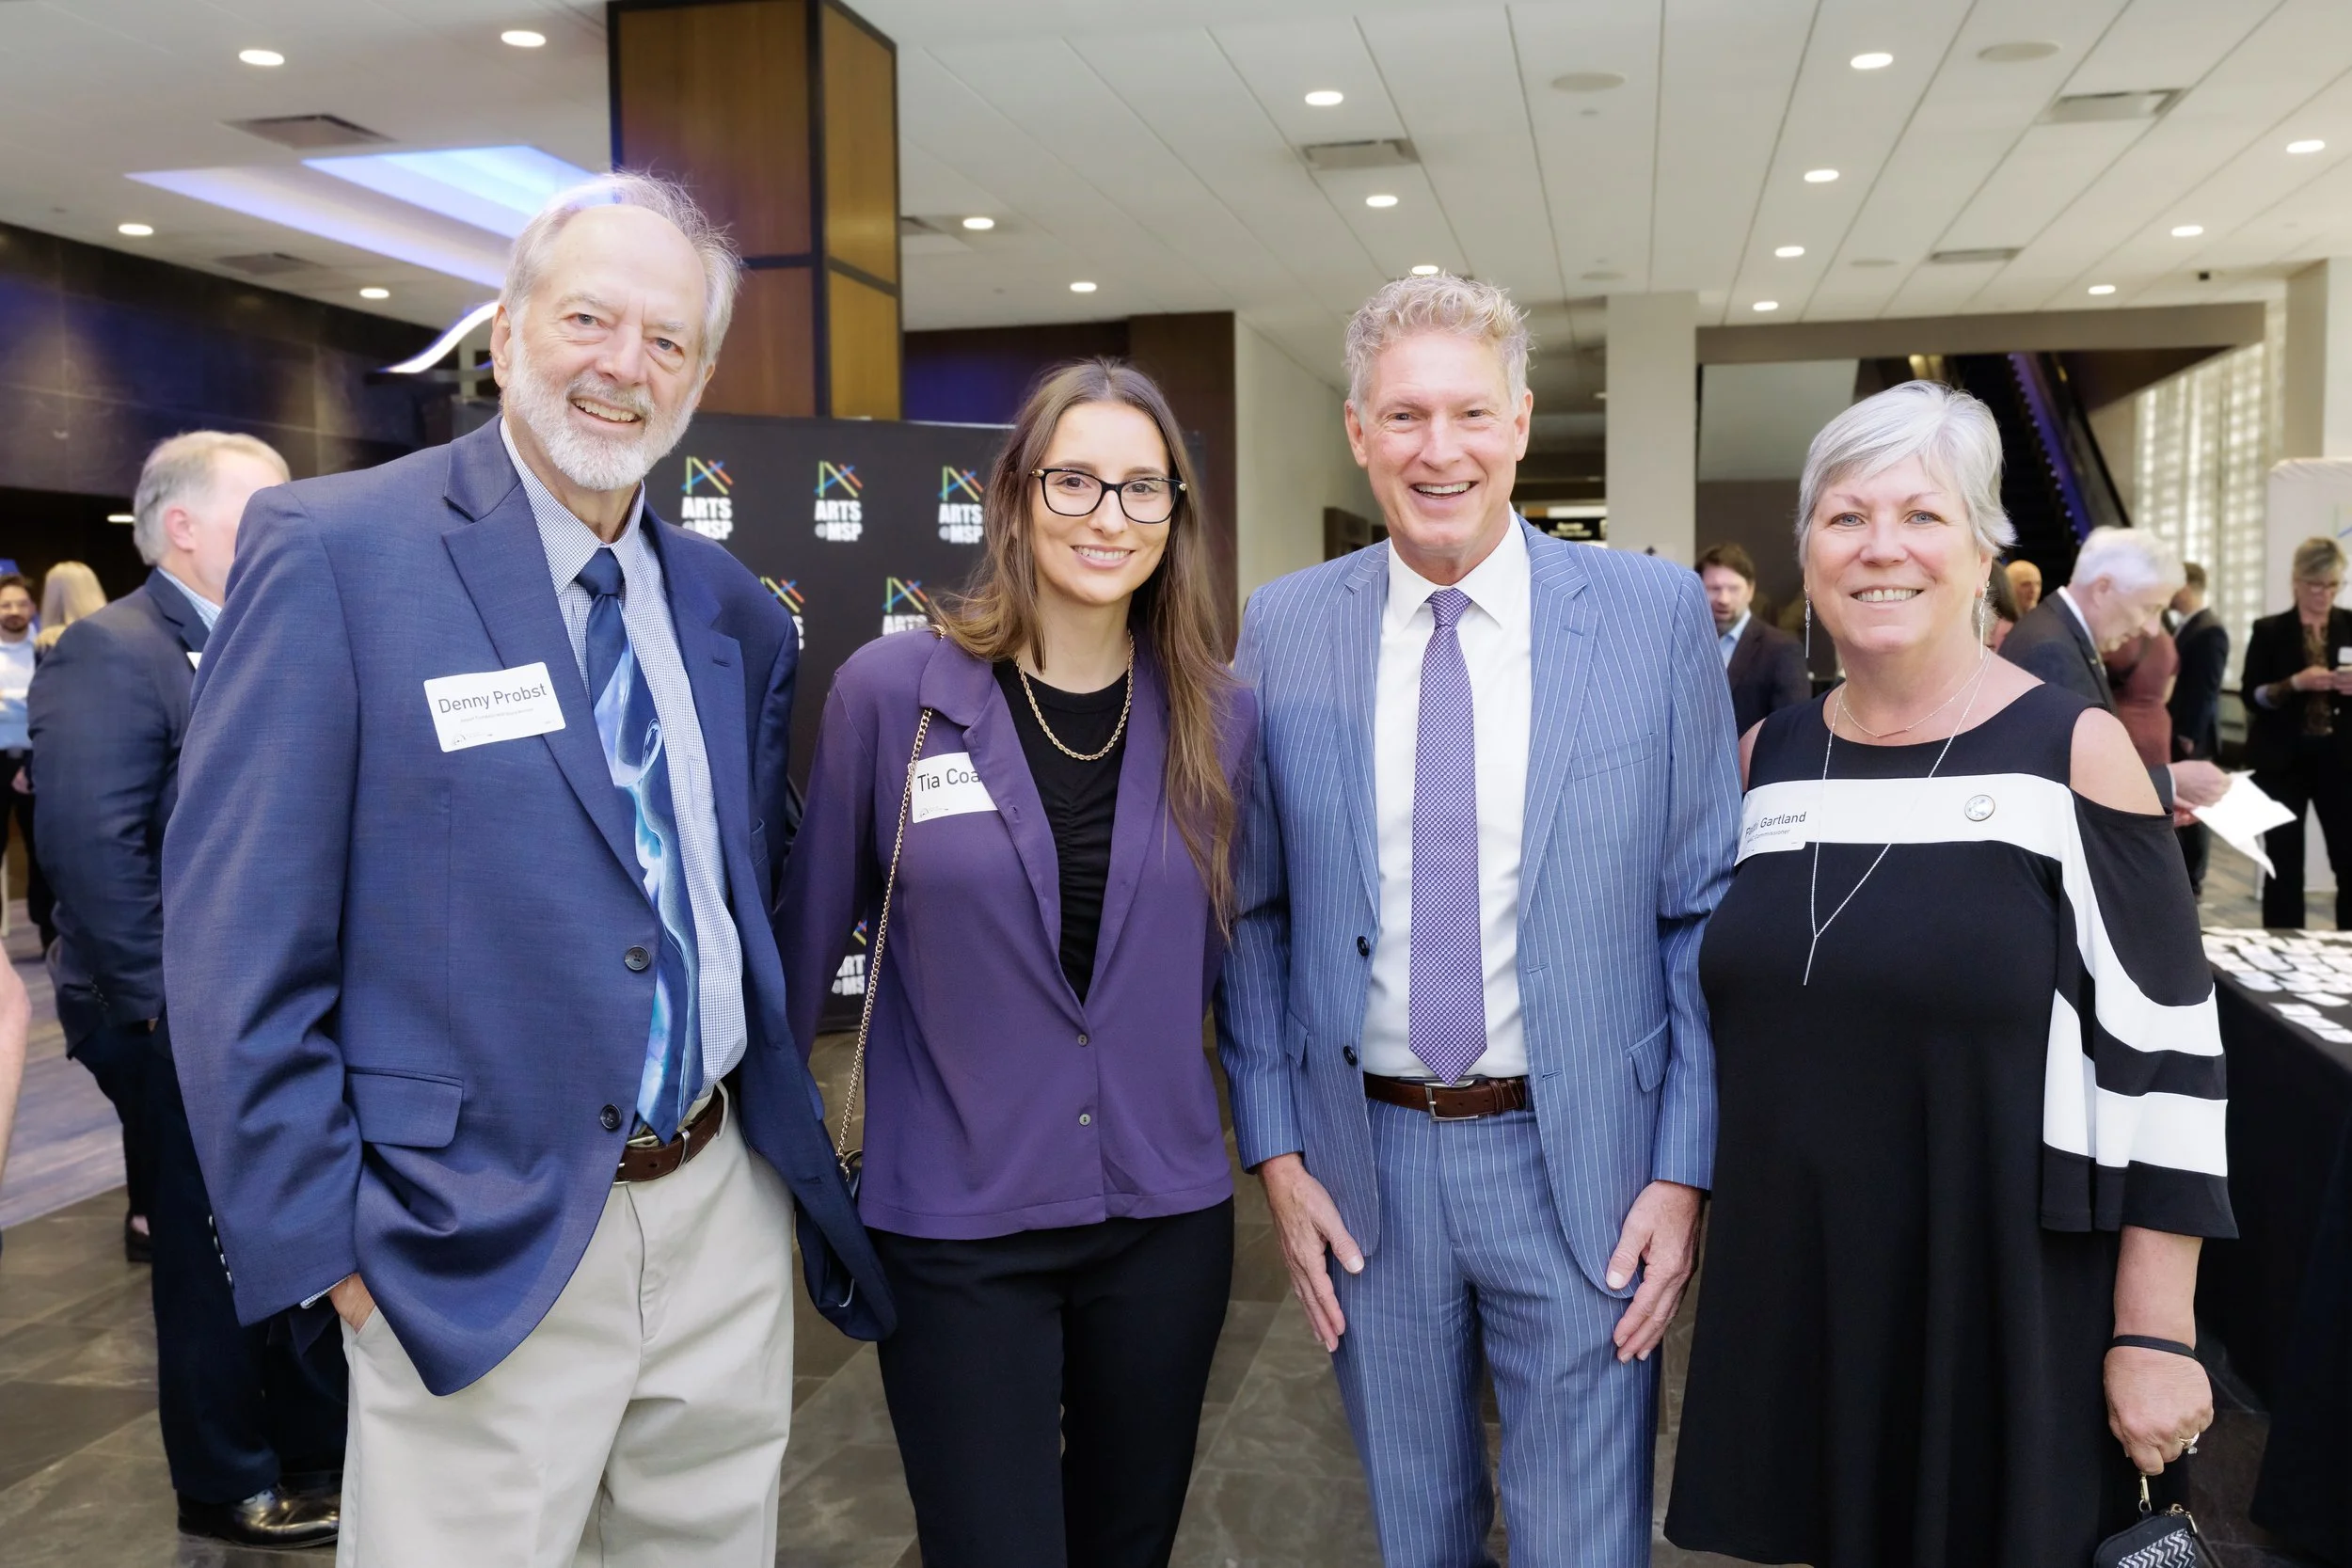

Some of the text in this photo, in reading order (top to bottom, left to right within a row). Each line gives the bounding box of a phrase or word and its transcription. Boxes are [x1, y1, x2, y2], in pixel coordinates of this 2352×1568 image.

[681, 497, 733, 519] ARTS
[815, 499, 862, 521] ARTS
[938, 503, 983, 524] ARTS
[438, 683, 548, 714] Denny Probst
[917, 773, 940, 791] Tia
[1760, 811, 1806, 828] Gartland
